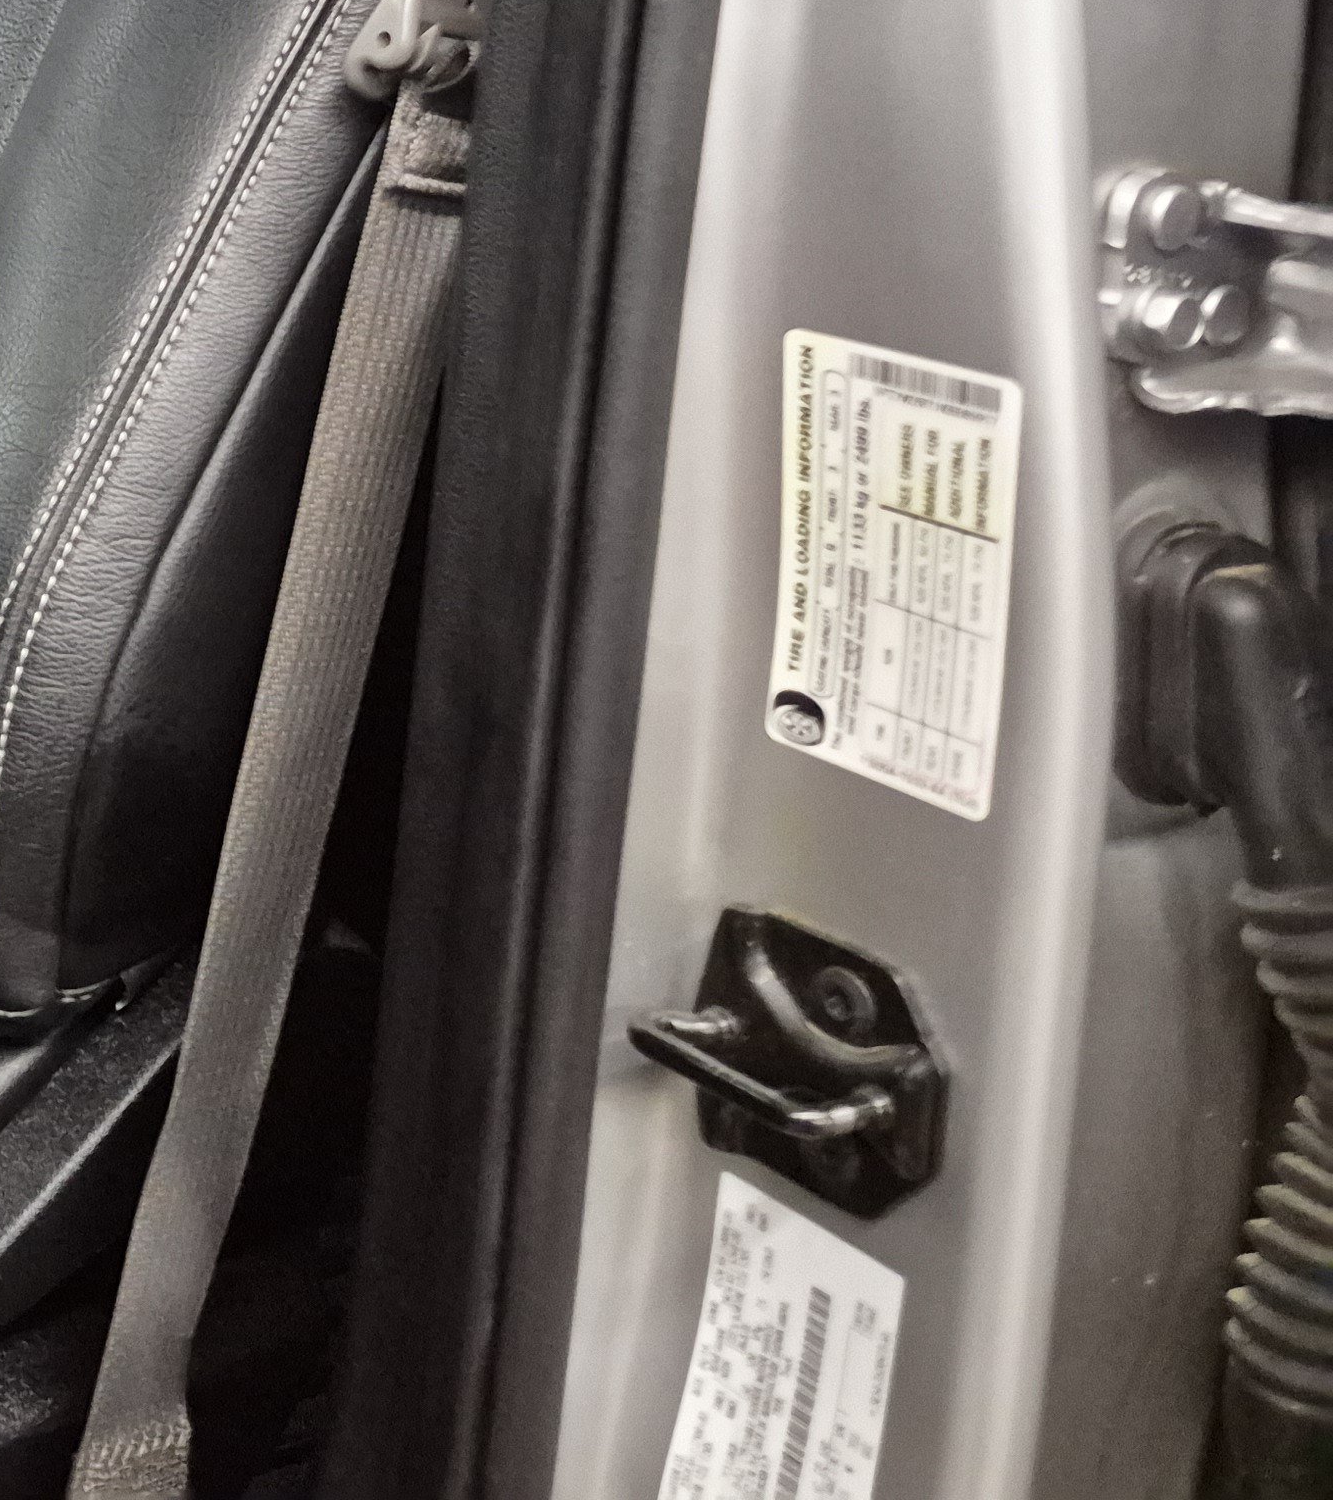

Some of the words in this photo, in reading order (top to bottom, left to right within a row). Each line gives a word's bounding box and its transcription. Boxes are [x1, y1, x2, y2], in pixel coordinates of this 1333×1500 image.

[795, 344, 814, 483] INFORMATION
[795, 488, 811, 576] LOADING
[793, 581, 806, 623] AND
[789, 629, 804, 672] TIRE
